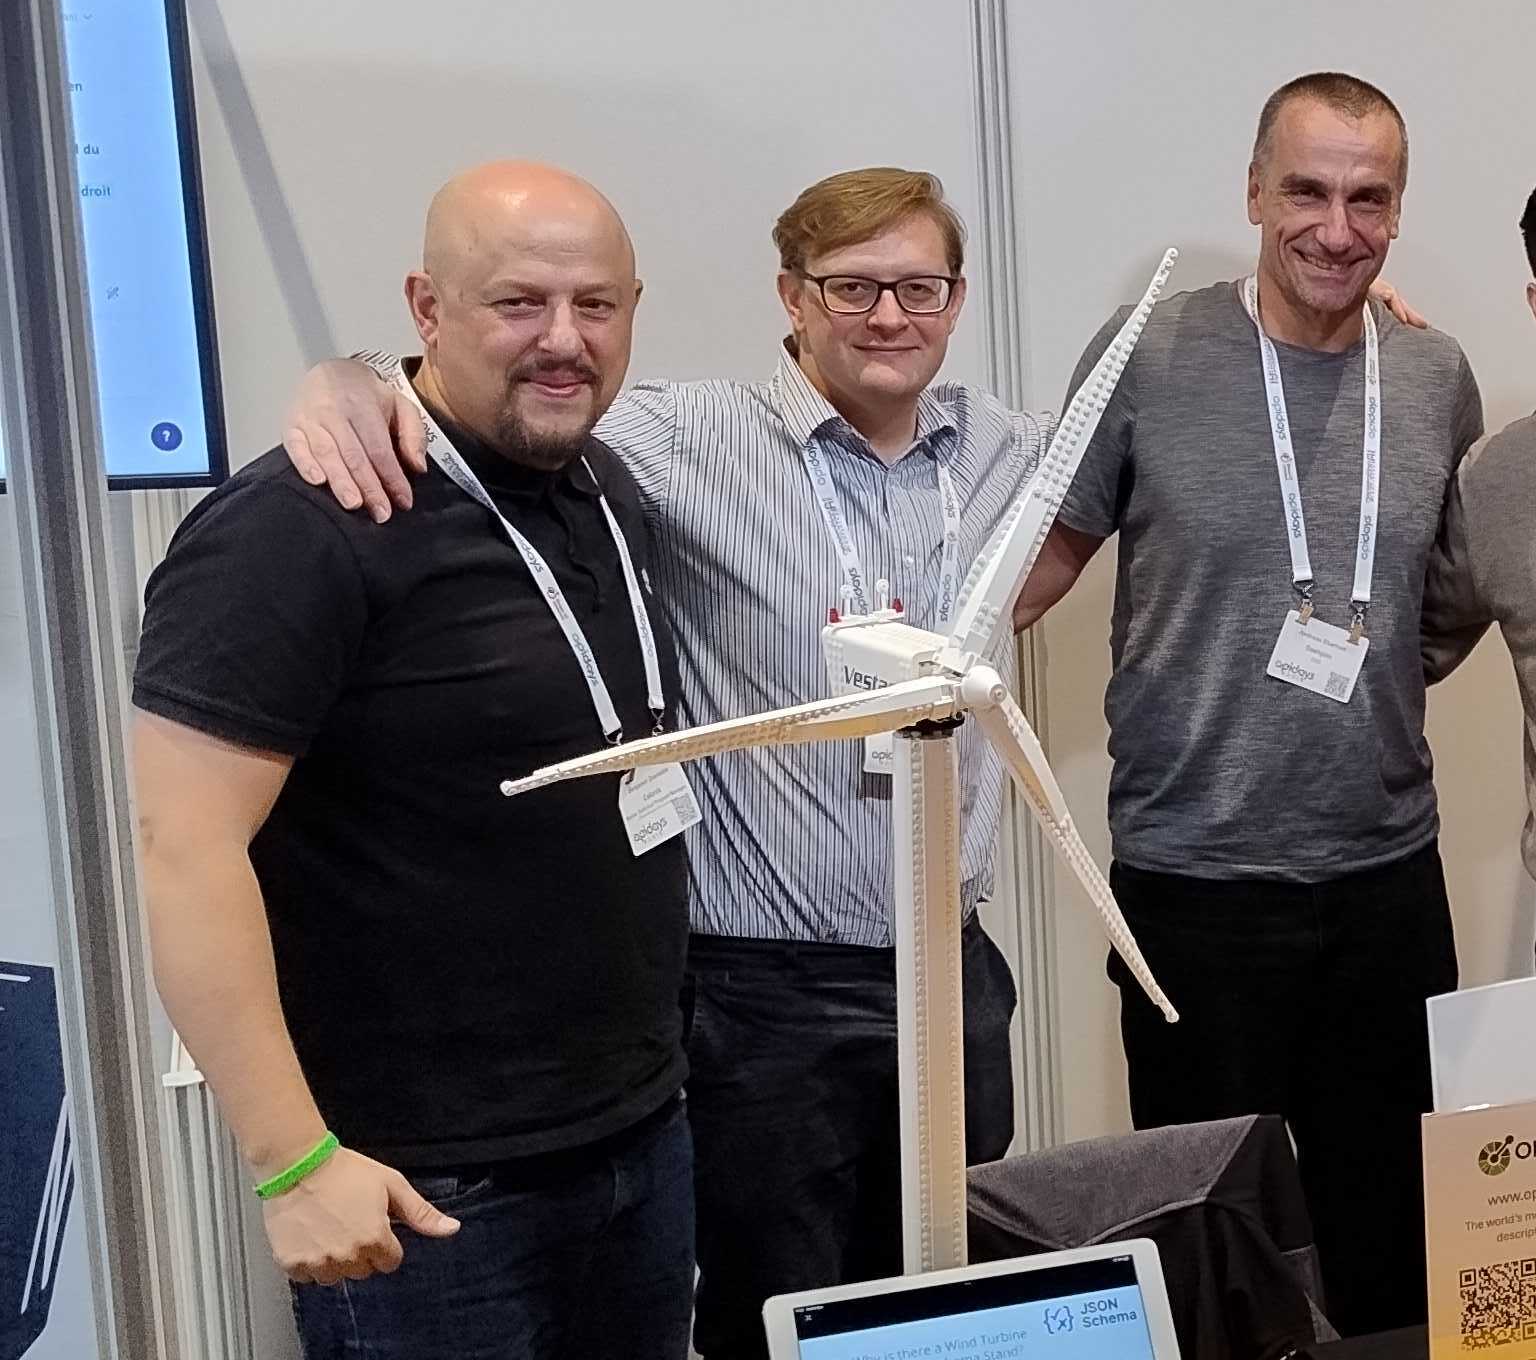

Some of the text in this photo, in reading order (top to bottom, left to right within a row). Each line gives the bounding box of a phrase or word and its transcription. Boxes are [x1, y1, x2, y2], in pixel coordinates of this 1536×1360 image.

[844, 664, 897, 691] Vesta
[1465, 1219, 1485, 1232] The
[1486, 1210, 1523, 1228] world's
[1080, 1297, 1119, 1315] JSON
[1082, 1310, 1138, 1328] Schema
[896, 1345, 932, 1360] there
[934, 1343, 943, 1354] a
[944, 1337, 977, 1352] Wind
[980, 1328, 1028, 1345] Turbine
